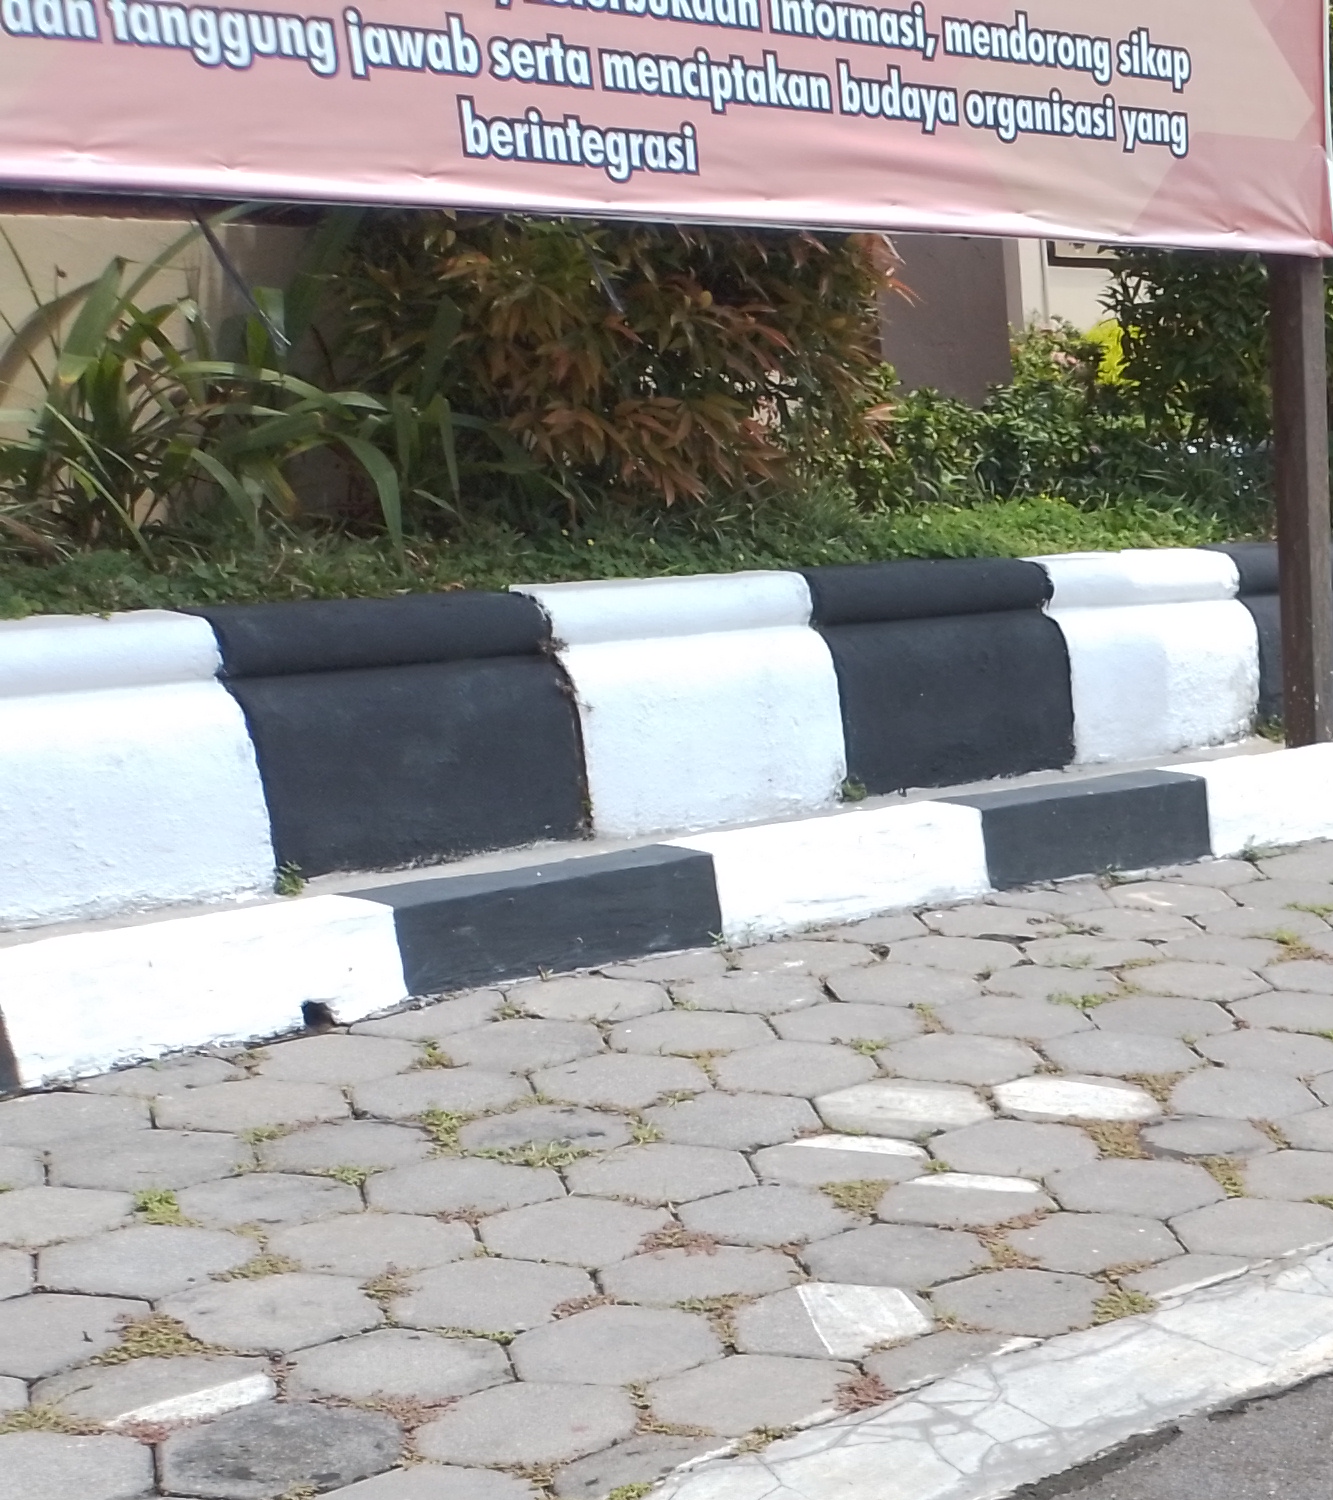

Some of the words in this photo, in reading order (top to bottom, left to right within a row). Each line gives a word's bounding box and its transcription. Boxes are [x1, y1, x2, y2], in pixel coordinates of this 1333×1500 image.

[105, 0, 339, 77] tanggung
[345, 10, 482, 80] jawab
[488, 33, 594, 90] serta
[598, 46, 833, 114] menciptakan
[836, 58, 959, 134] budaya
[964, 88, 1116, 143] organisasi
[1119, 106, 1188, 159] yang
[770, 0, 939, 61] informasi,
[943, 11, 1111, 85] mendorong
[1117, 27, 1191, 93] sikap
[456, 95, 700, 181] berintegrasi
